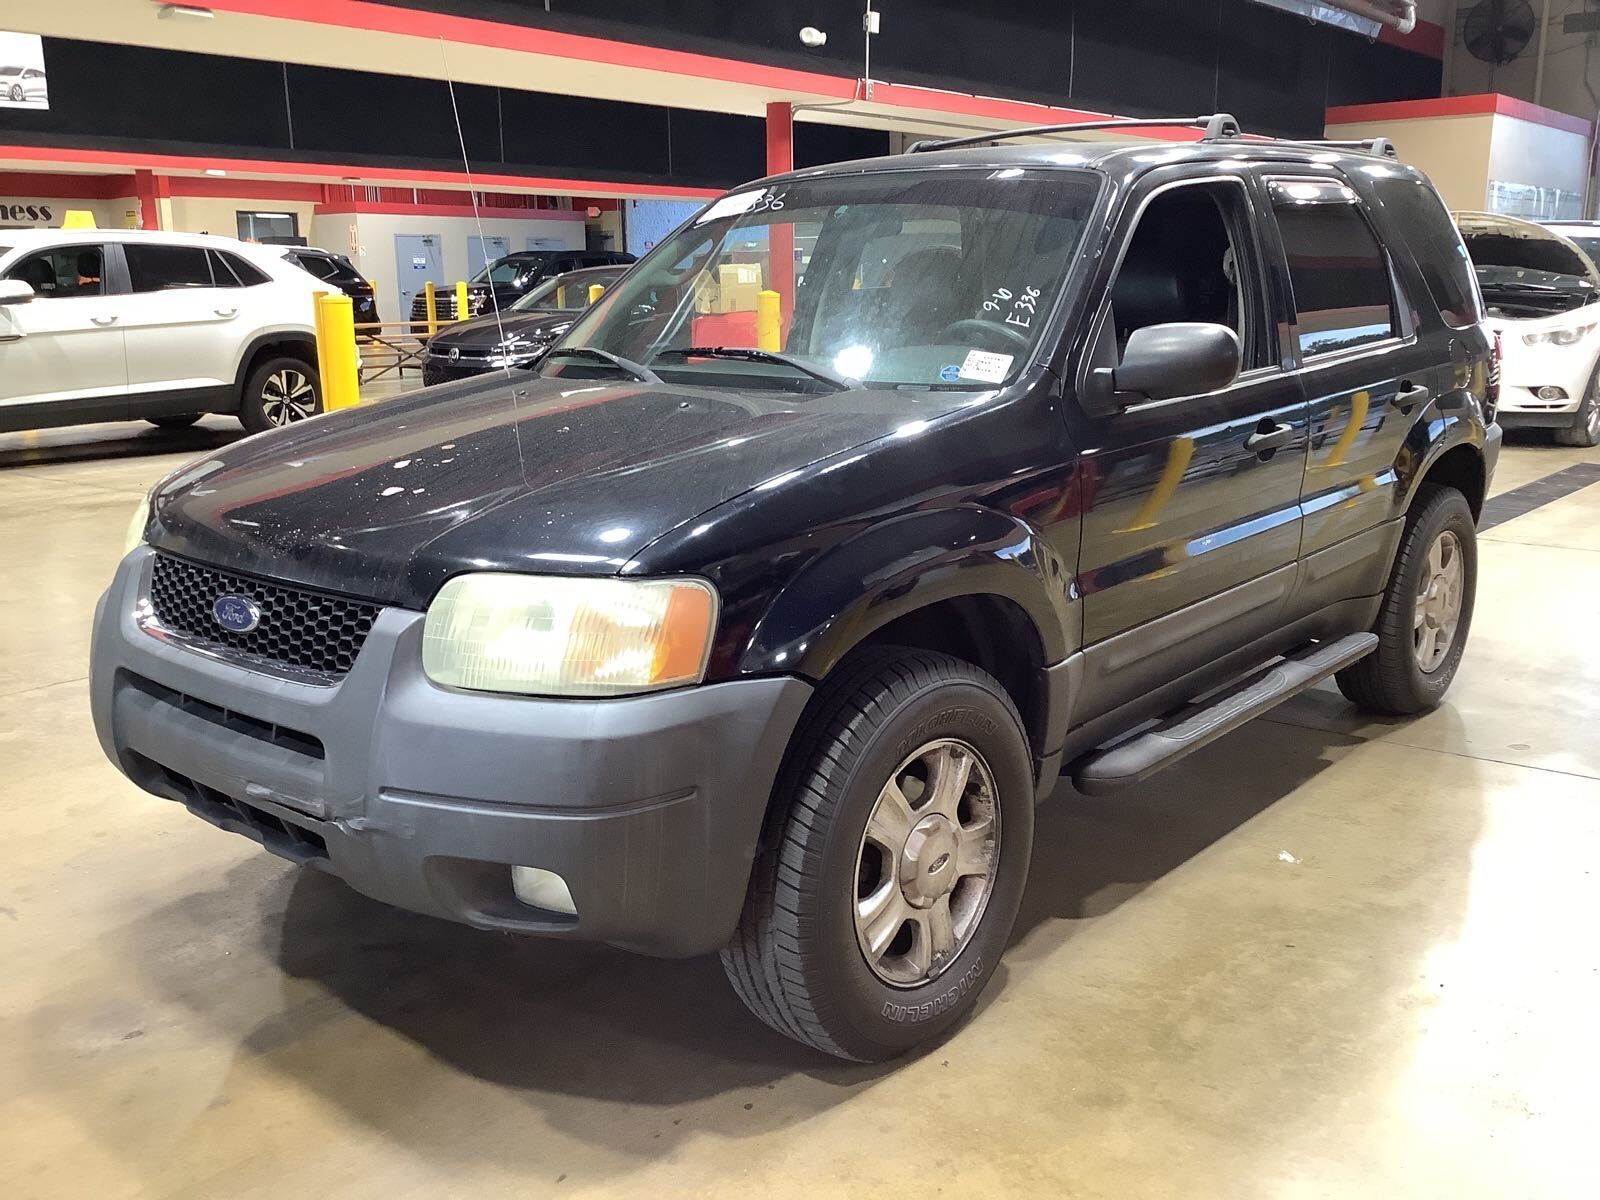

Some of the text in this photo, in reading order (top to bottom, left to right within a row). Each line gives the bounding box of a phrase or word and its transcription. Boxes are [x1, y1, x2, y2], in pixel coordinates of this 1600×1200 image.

[221, 602, 247, 624] Ford
[896, 708, 999, 757] MICHELIN
[881, 957, 984, 1022] MICHELIN
